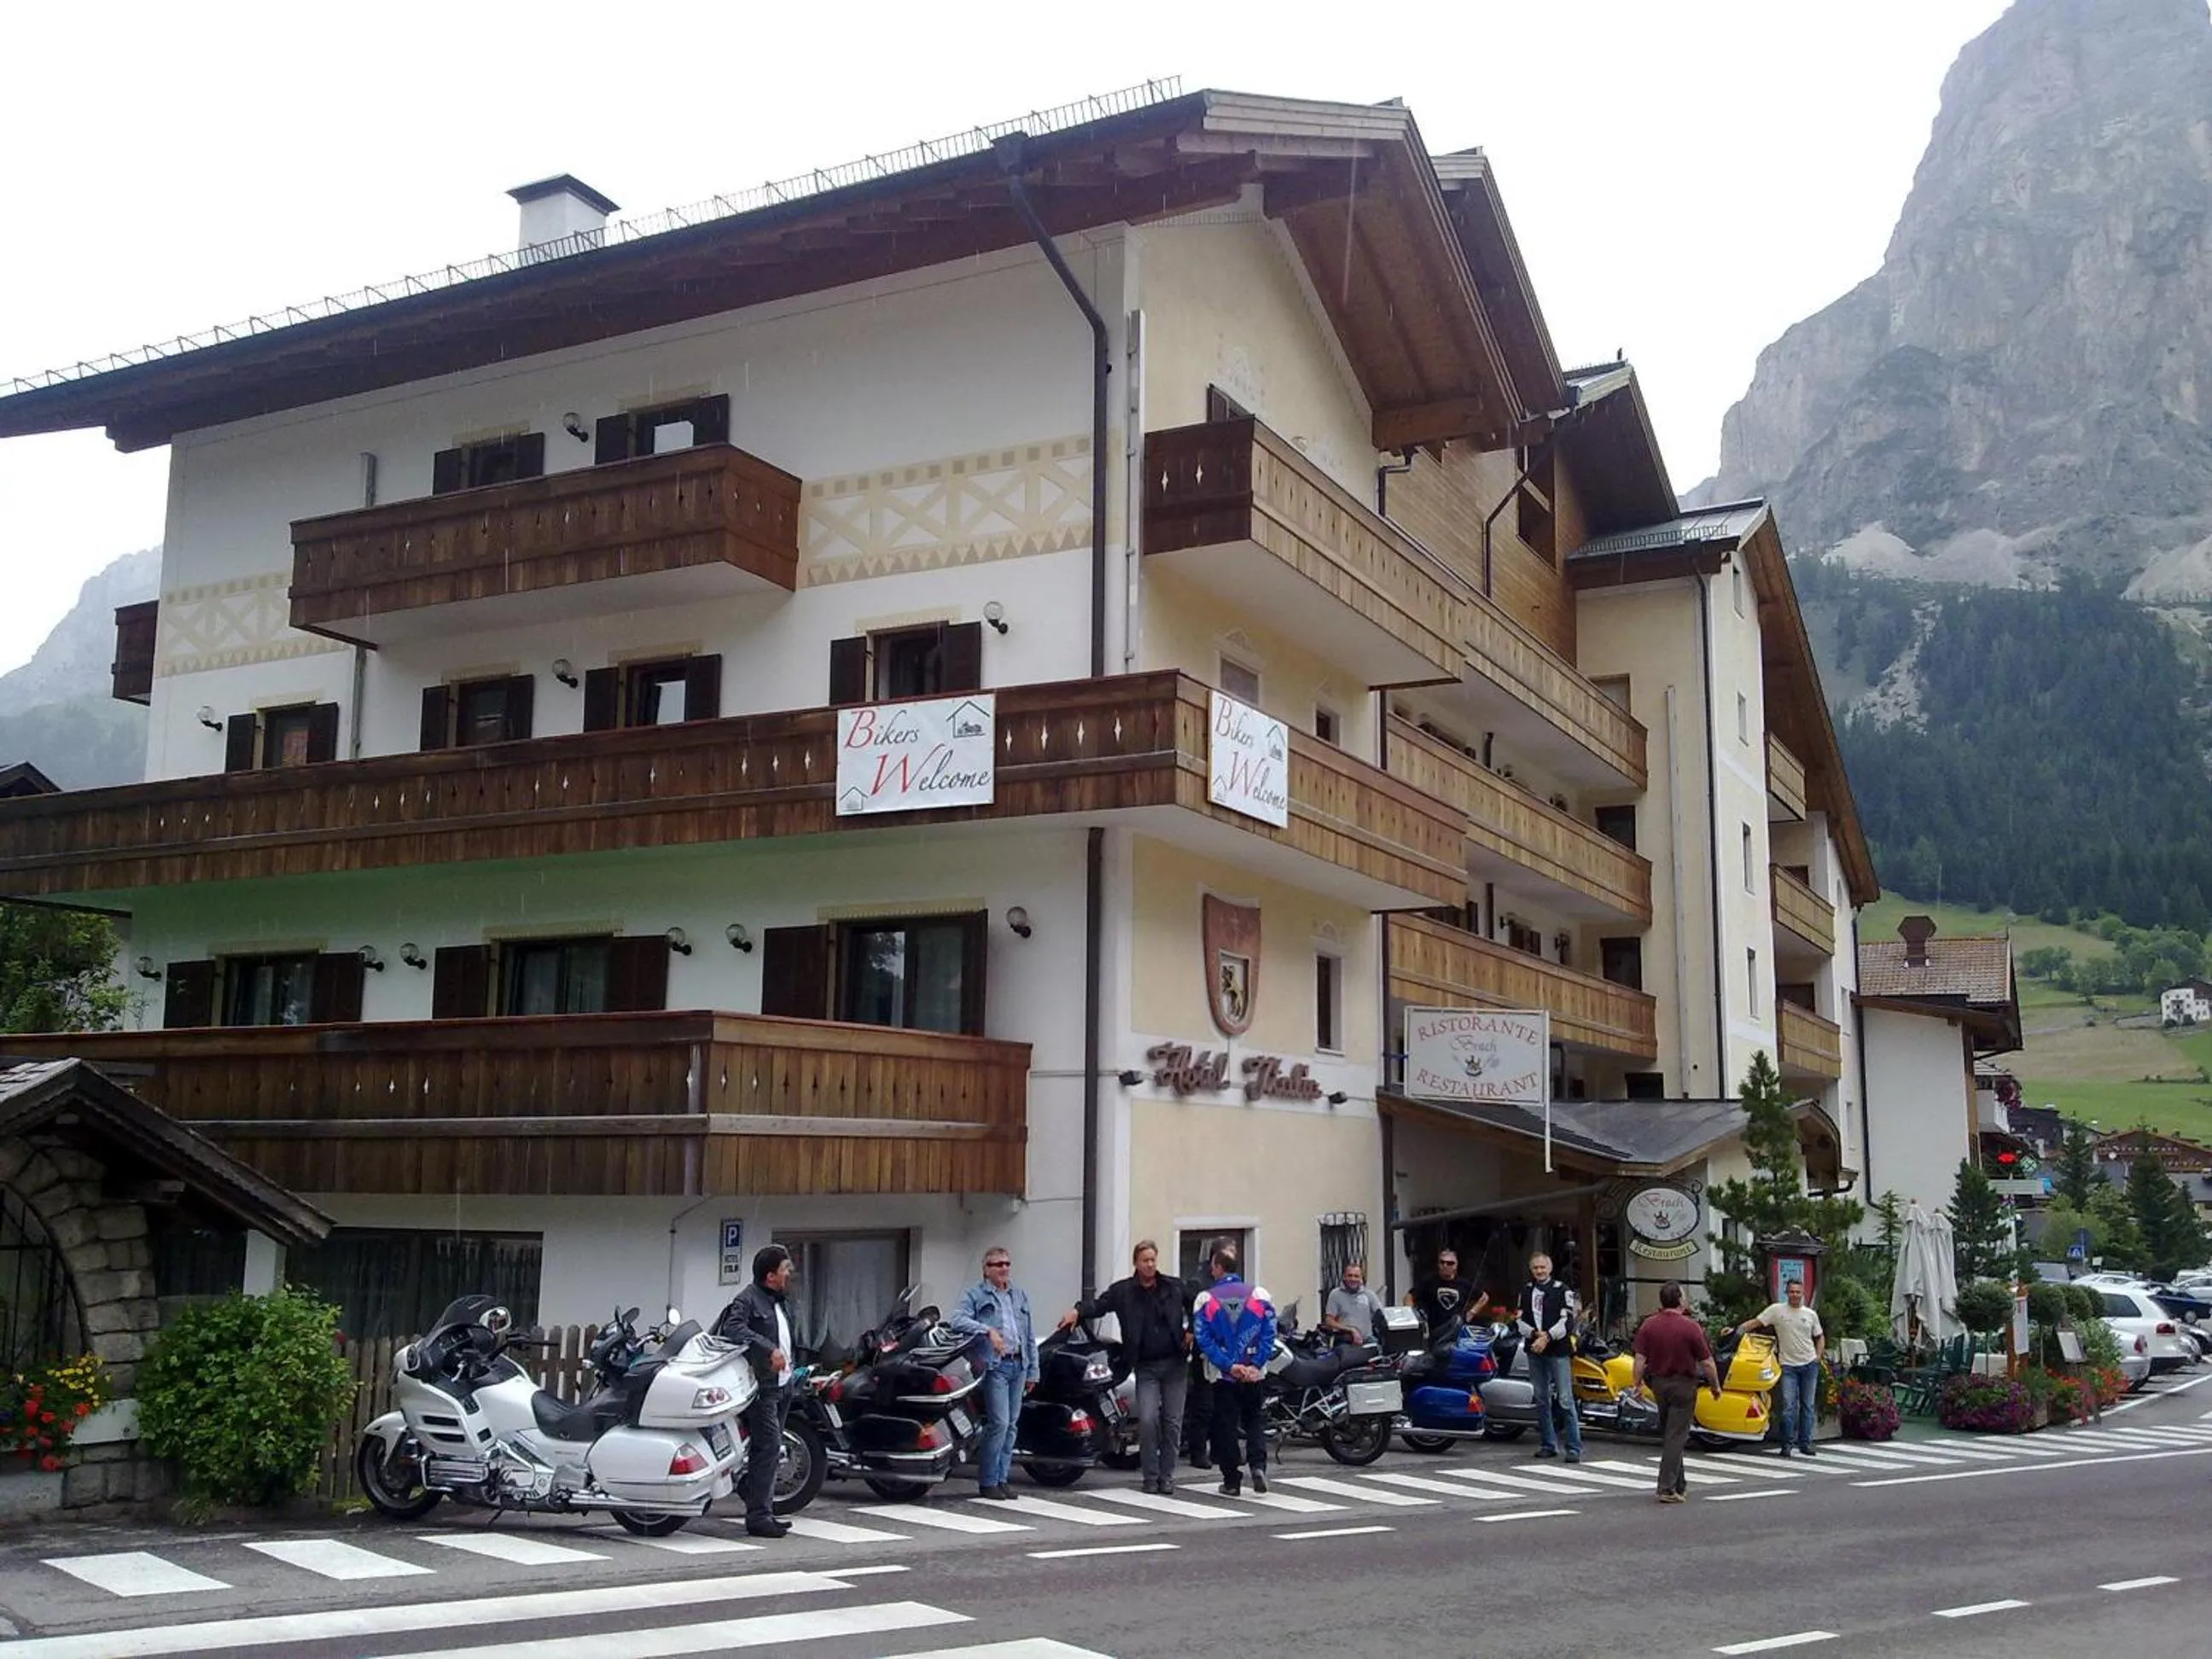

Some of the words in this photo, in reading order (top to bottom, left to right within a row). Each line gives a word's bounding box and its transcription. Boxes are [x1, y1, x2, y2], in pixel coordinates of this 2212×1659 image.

[844, 709, 921, 749] Bikers
[1215, 696, 1254, 748] Bikers
[870, 742, 991, 796] Welcome
[1228, 751, 1285, 811] Welcome
[1417, 1014, 1539, 1045] RISTORANTE
[1147, 1041, 1231, 1097] Hotel
[1417, 1068, 1538, 1097] RESTAURANT
[728, 1226, 738, 1245] P
